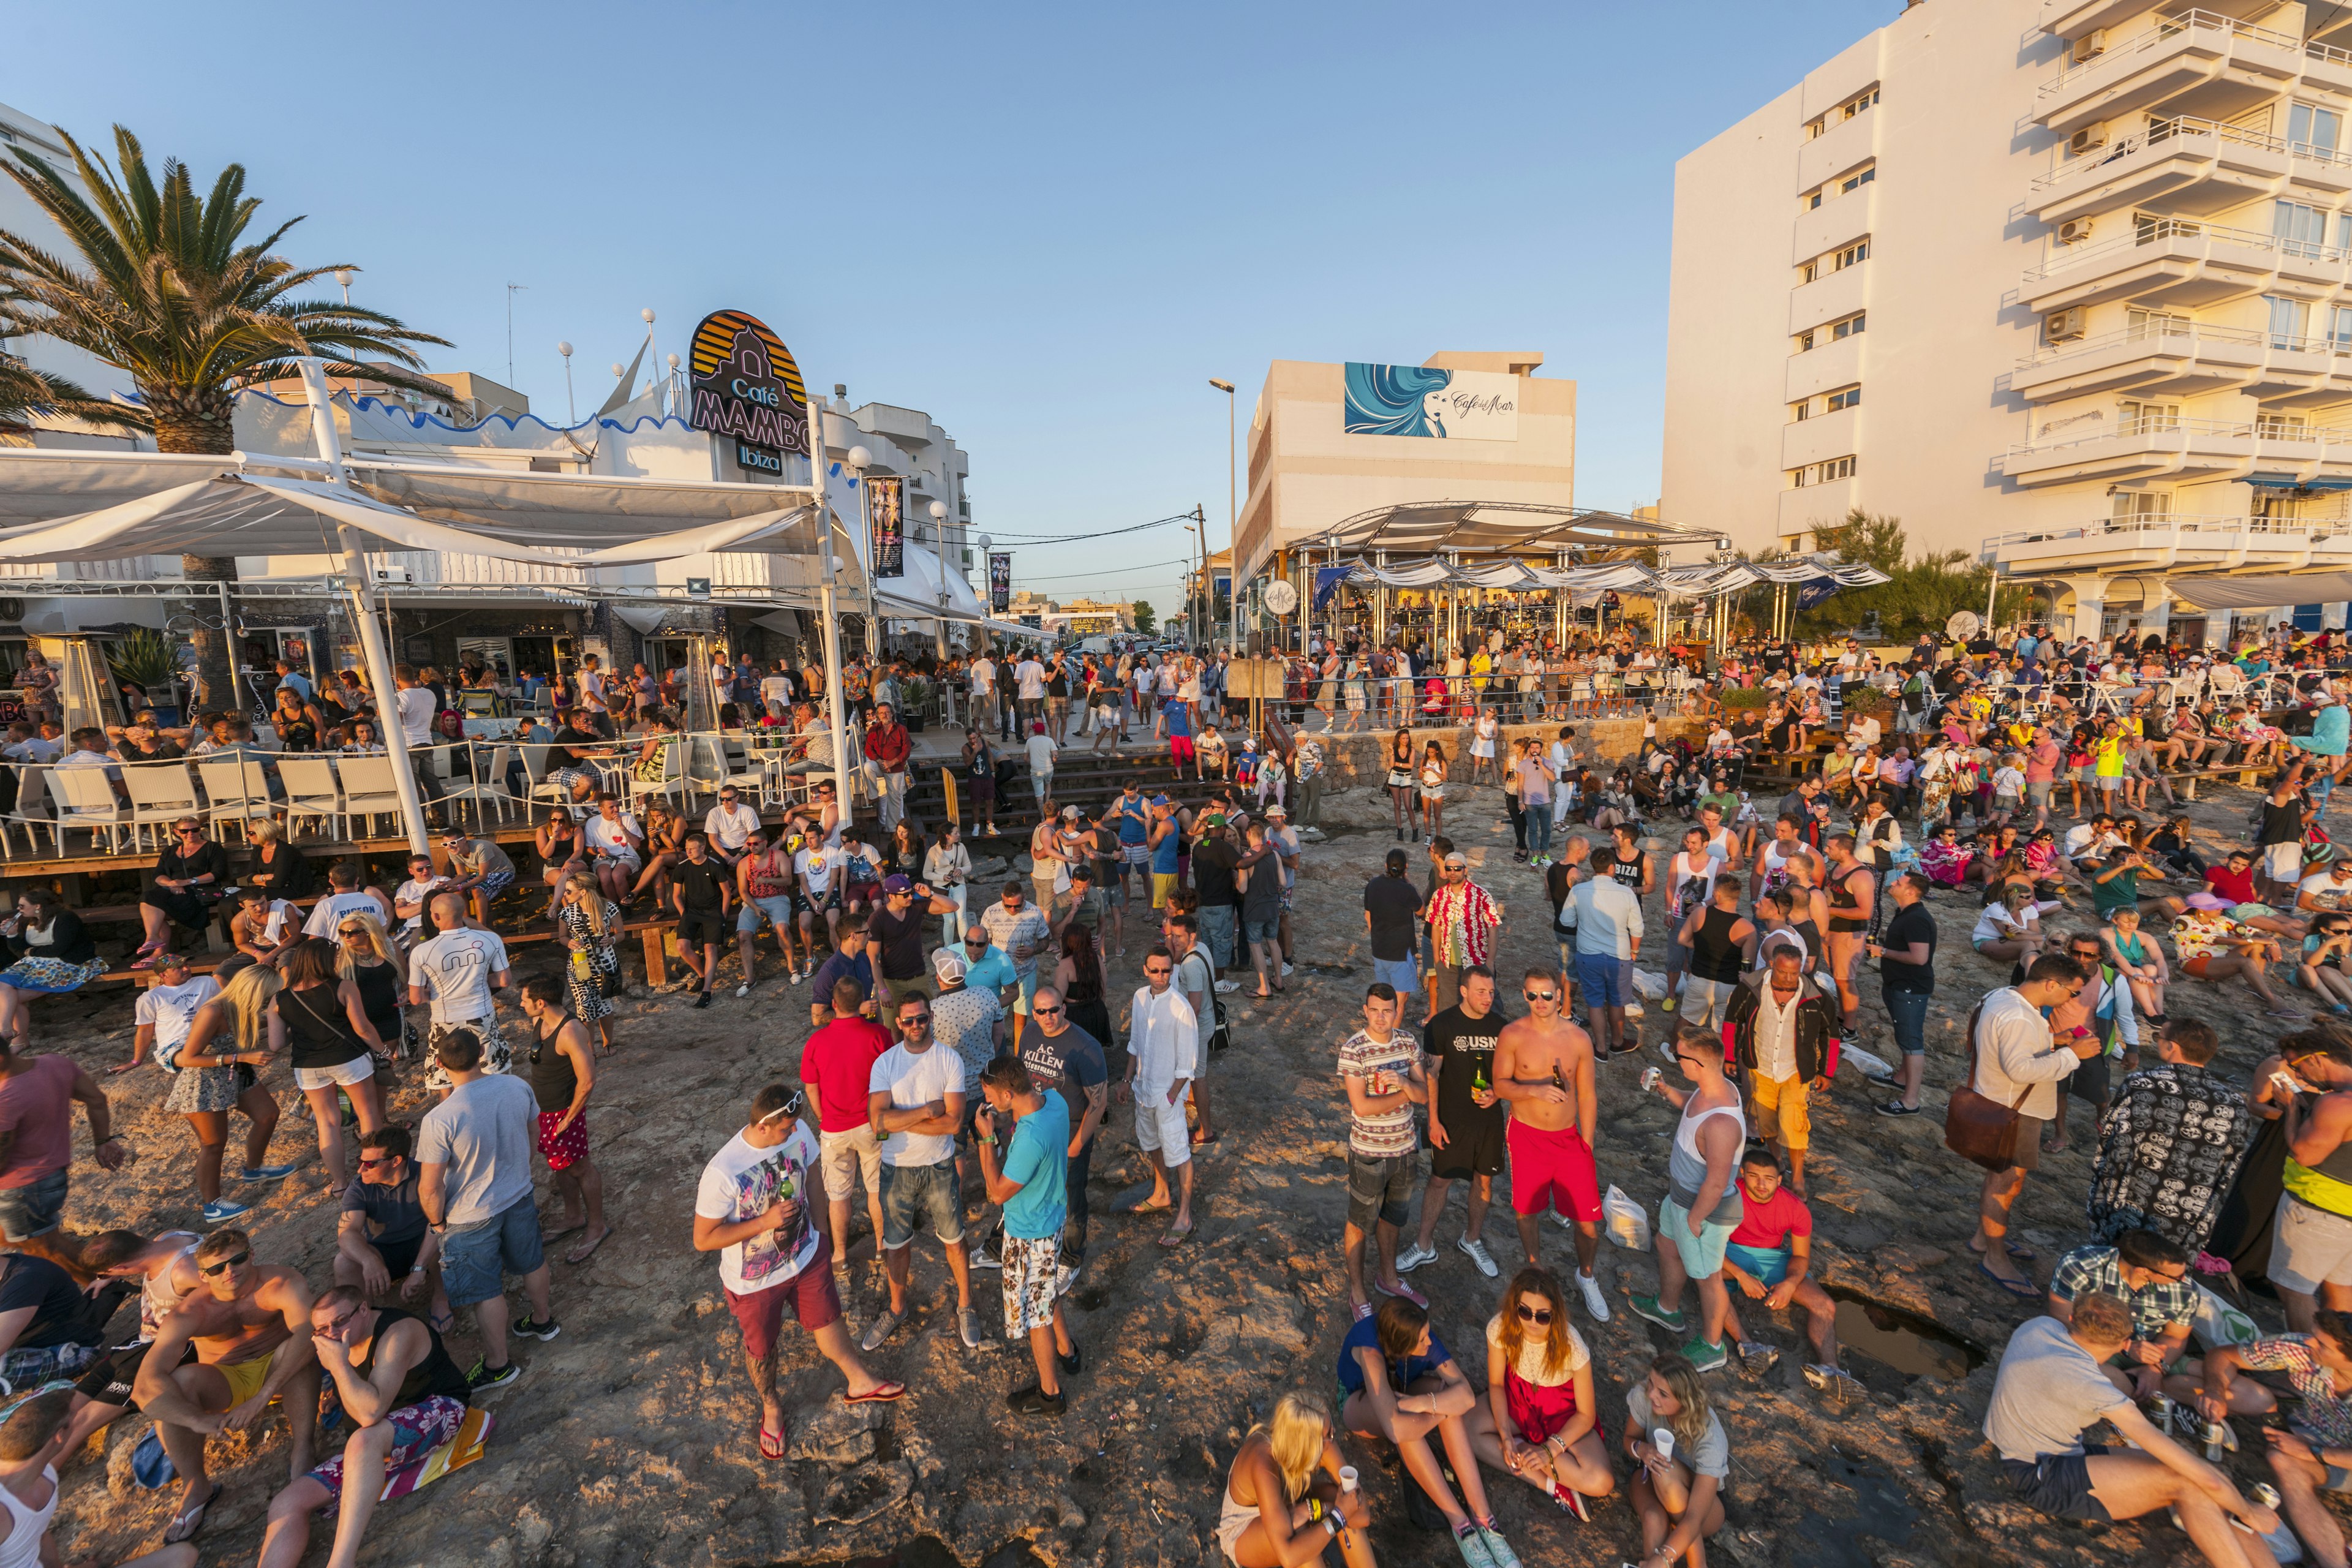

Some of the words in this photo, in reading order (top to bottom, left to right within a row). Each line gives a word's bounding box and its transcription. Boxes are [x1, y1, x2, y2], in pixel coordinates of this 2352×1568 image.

[731, 378, 779, 407] Café
[1451, 391, 1478, 418] Café
[1477, 399, 1488, 410] del
[1487, 394, 1515, 415] Mar
[739, 446, 780, 471] Ibiza
[875, 536, 902, 545] PACHA
[1267, 586, 1283, 608] Café
[1615, 864, 1638, 877] BIZA
[1036, 1044, 1054, 1055] A.C
[1468, 1036, 1498, 1048] USN
[1024, 1049, 1065, 1069] KILLEN
[105, 1381, 133, 1392] BOSS
